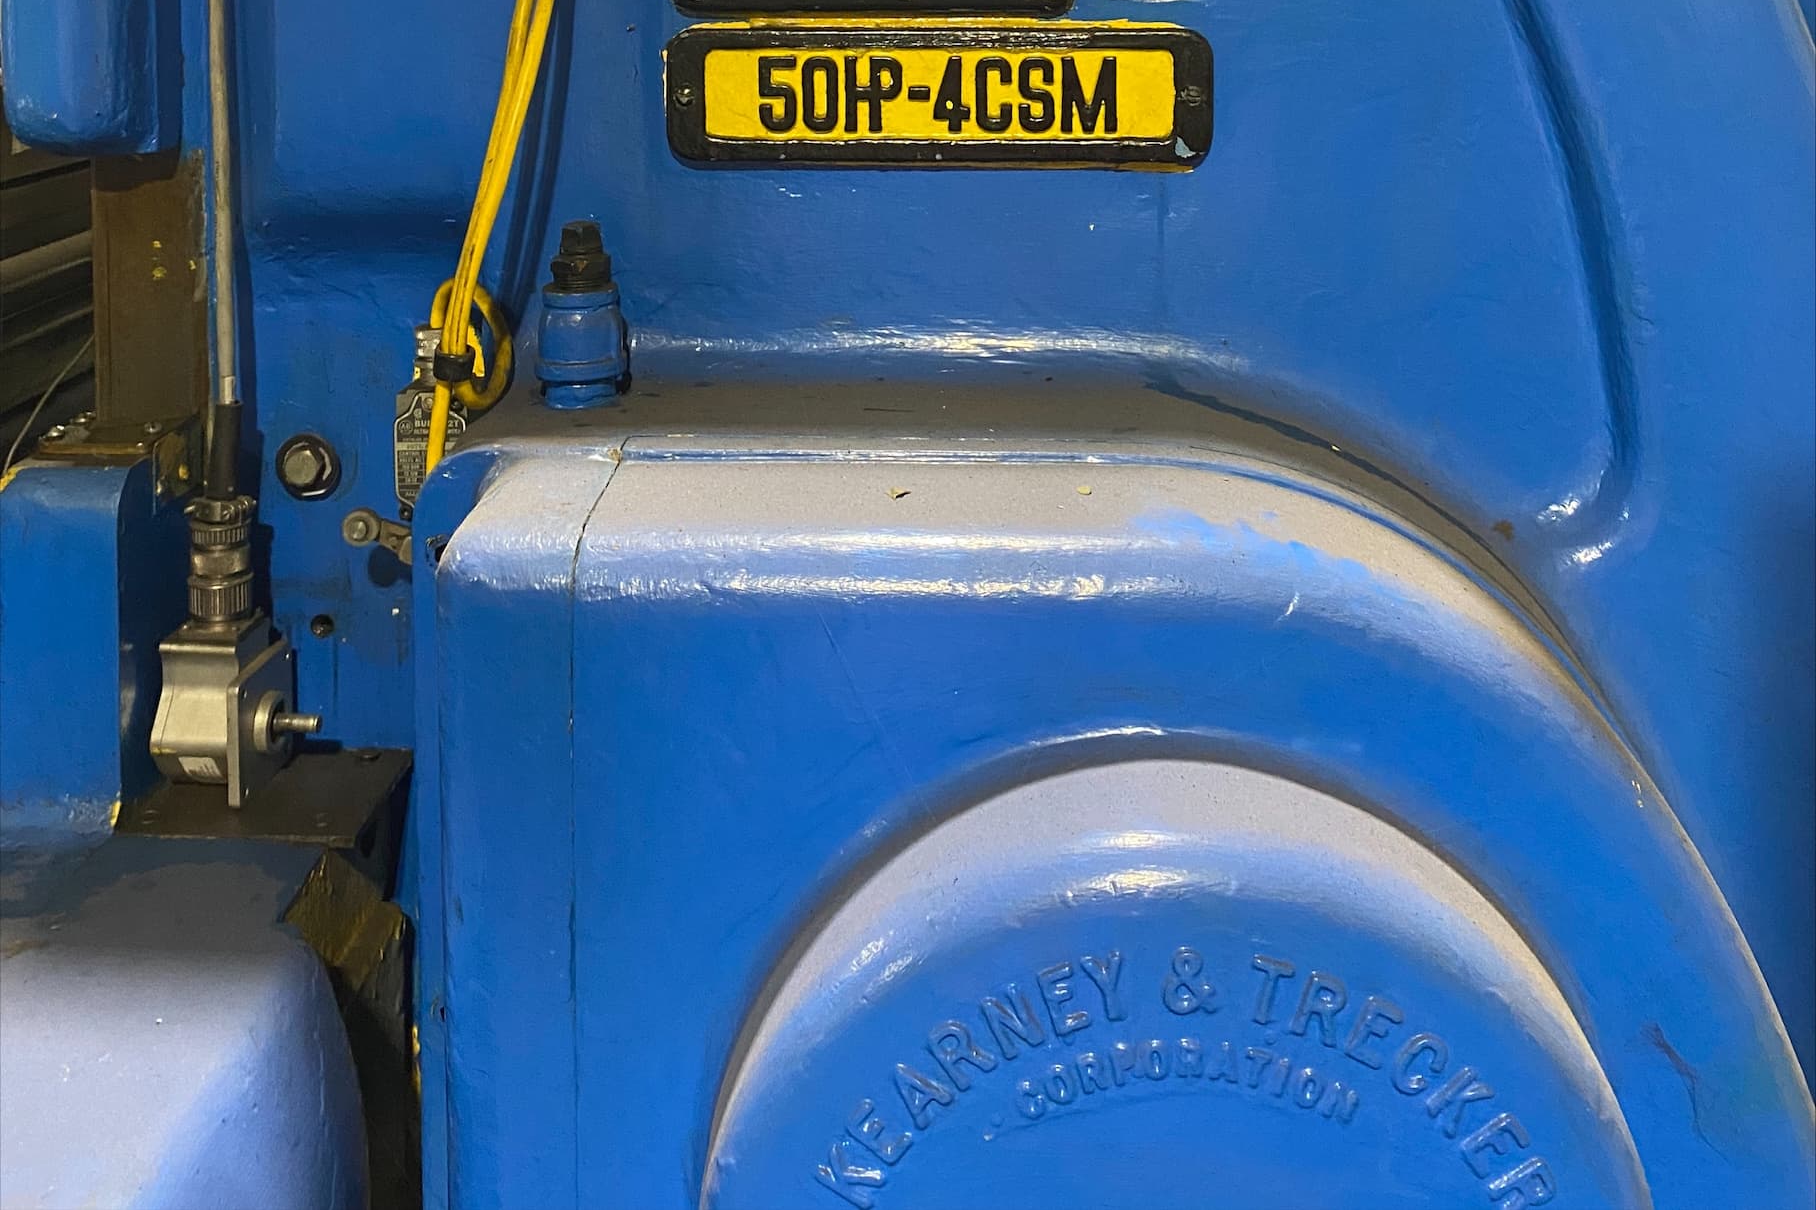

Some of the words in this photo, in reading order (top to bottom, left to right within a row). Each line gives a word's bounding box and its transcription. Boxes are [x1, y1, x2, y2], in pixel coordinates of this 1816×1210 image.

[757, 55, 1119, 134] 50HP-4CSM
[813, 950, 1124, 1210] KEARNEY
[1160, 945, 1217, 1016] &
[1015, 1038, 1360, 1124] CORPORATION
